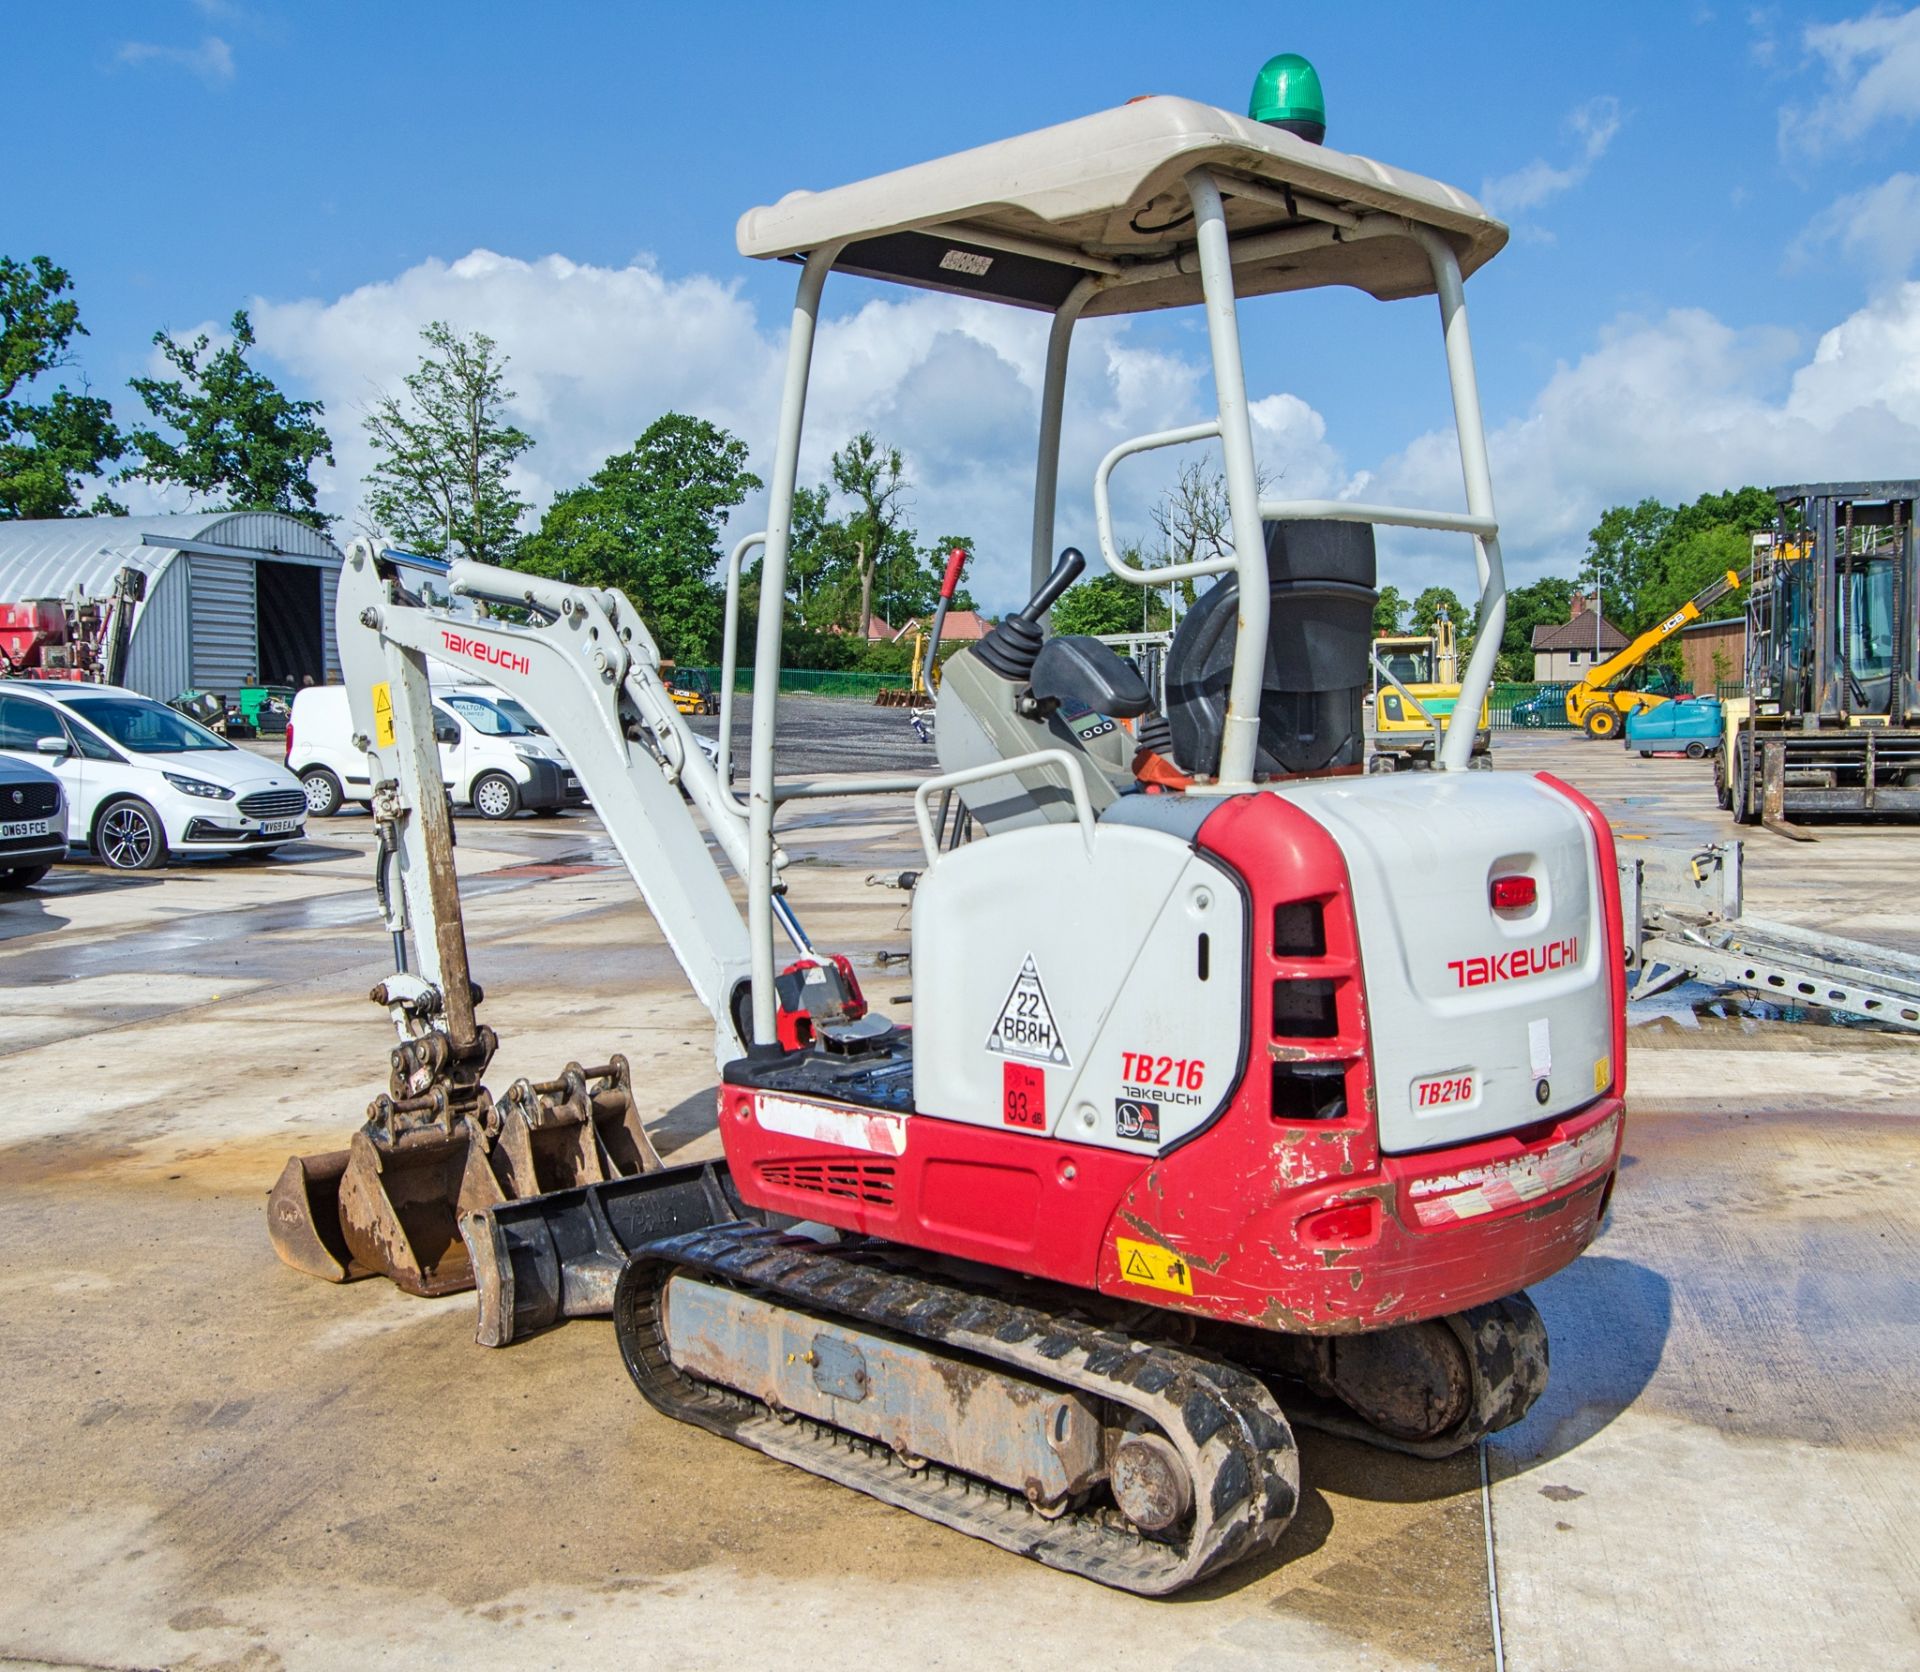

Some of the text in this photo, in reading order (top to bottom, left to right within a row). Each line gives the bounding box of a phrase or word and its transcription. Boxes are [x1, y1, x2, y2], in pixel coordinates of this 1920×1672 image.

[1662, 613, 1685, 633] JCB
[441, 631, 530, 675] TAKEUCHI
[29, 822, 47, 834] FCE
[1448, 936, 1577, 988] TAKEUCHI
[1017, 991, 1040, 1020] 22
[1004, 1017, 1051, 1050] BB8H
[1122, 1051, 1206, 1091] TB216
[1008, 1090, 1028, 1122] 93
[1122, 1085, 1202, 1106] TAKEUCHI
[1419, 1077, 1472, 1106] TB216
